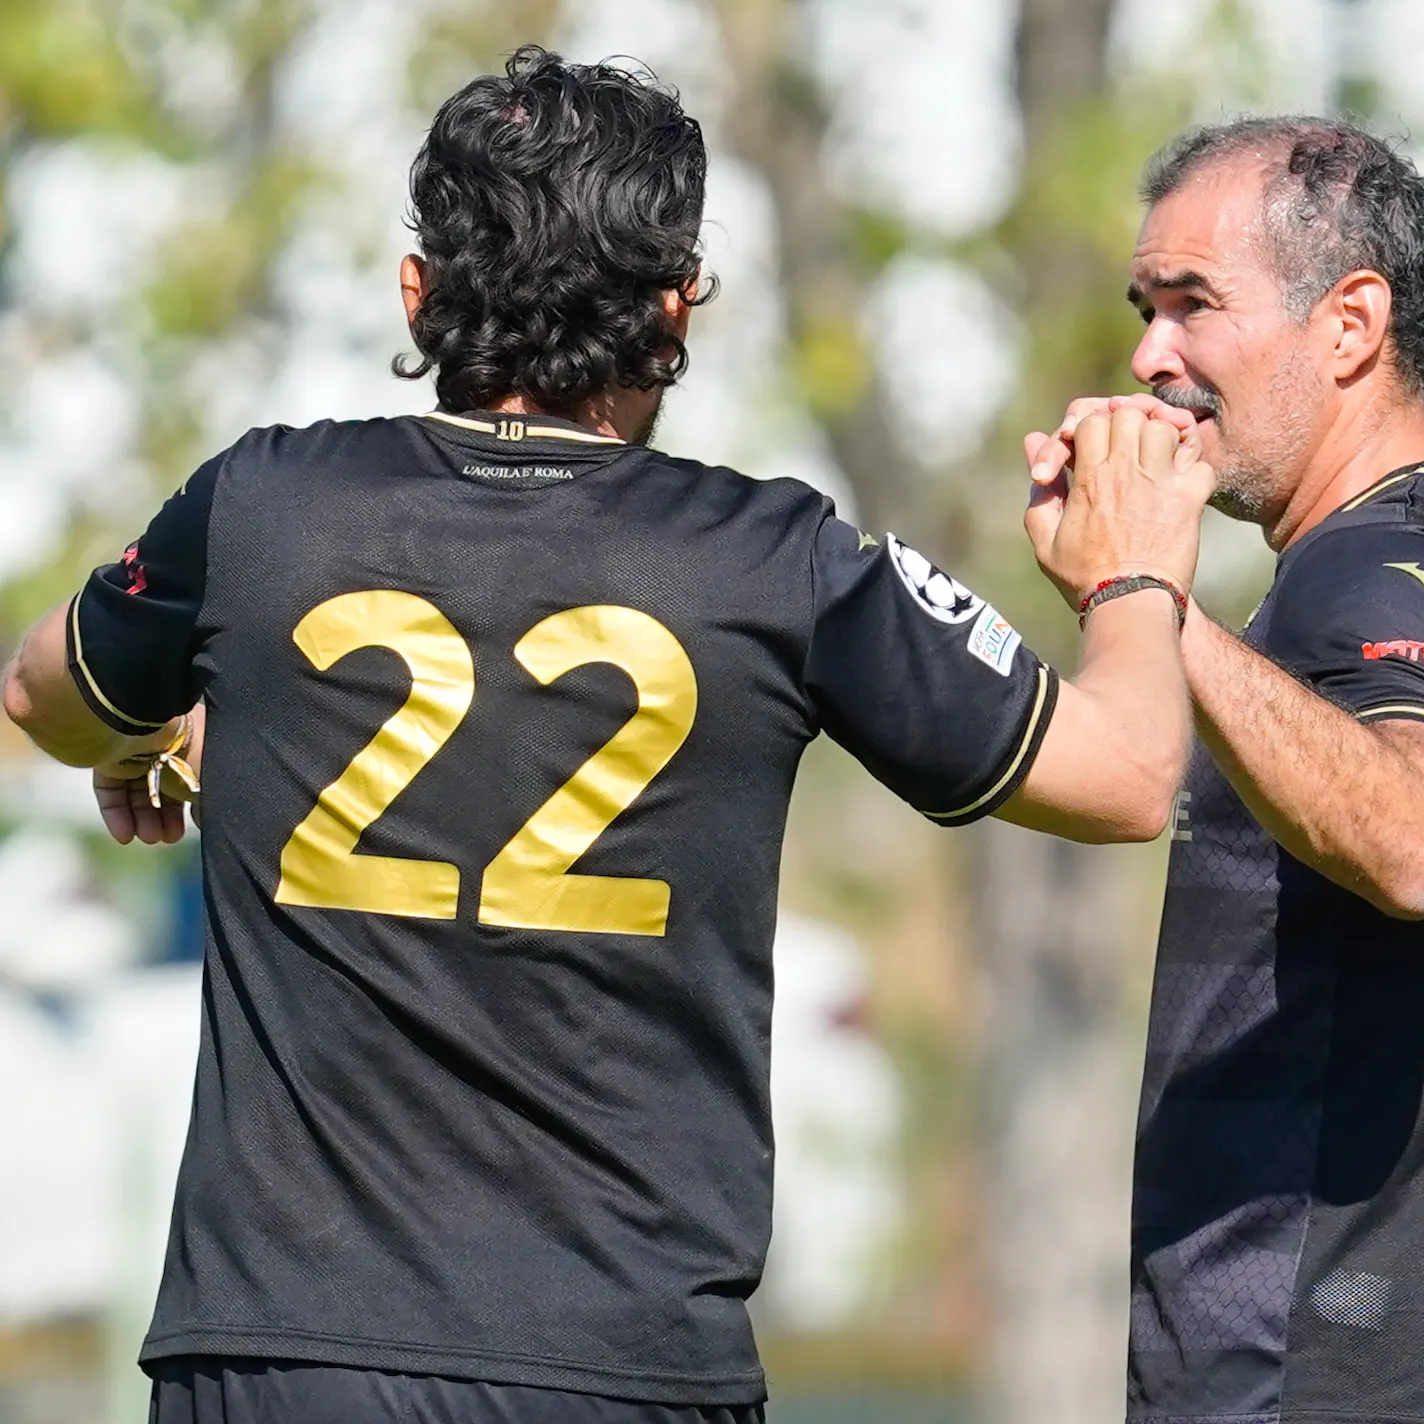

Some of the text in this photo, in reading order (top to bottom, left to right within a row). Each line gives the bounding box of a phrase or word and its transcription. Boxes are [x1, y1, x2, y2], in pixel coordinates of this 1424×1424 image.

[496, 420, 525, 441] 10
[462, 465, 521, 479] L'AQUILA
[534, 466, 574, 480] ROMA
[274, 589, 699, 937] 22
